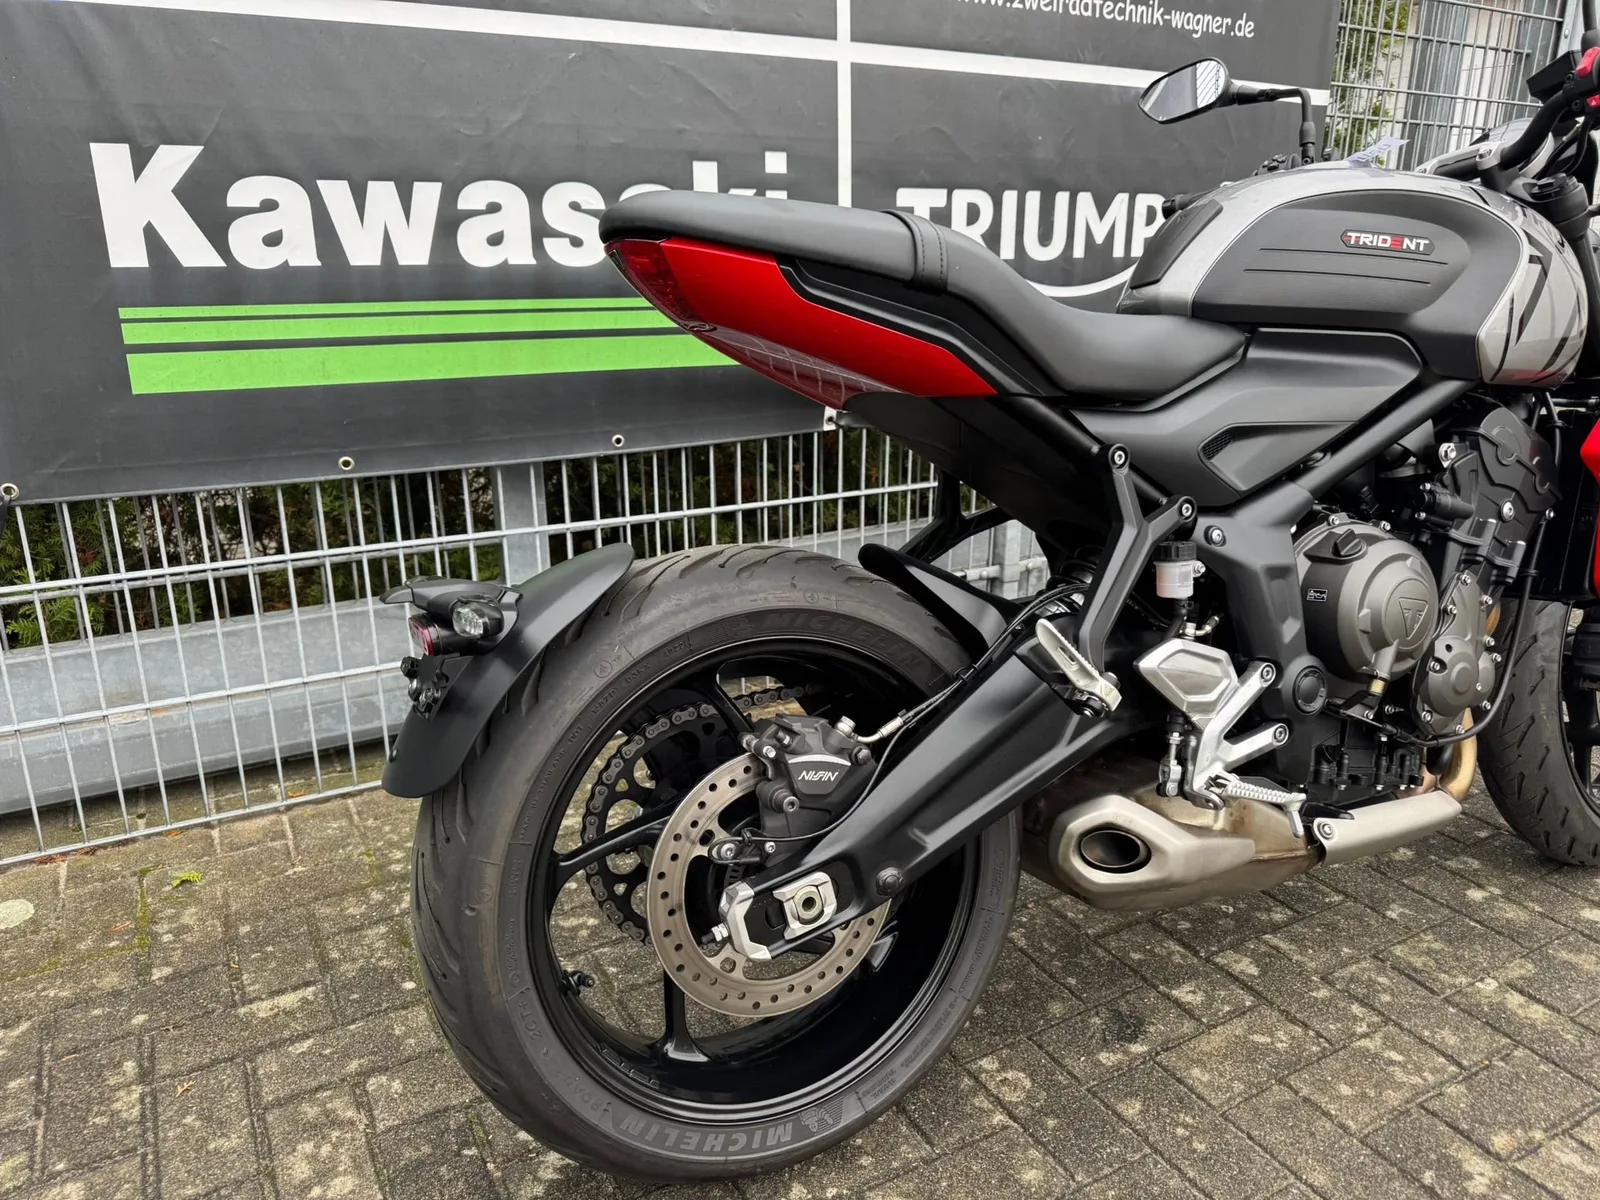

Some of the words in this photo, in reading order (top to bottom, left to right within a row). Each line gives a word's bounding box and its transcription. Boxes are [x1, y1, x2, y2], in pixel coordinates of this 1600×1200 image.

[957, 0, 1254, 38] .zweiradtechnik-wagner.de
[896, 187, 1167, 261] TRIUMP
[1344, 231, 1430, 252] TRIDENT
[798, 770, 839, 781] NISSIN
[618, 1109, 798, 1152] MICHELIN
